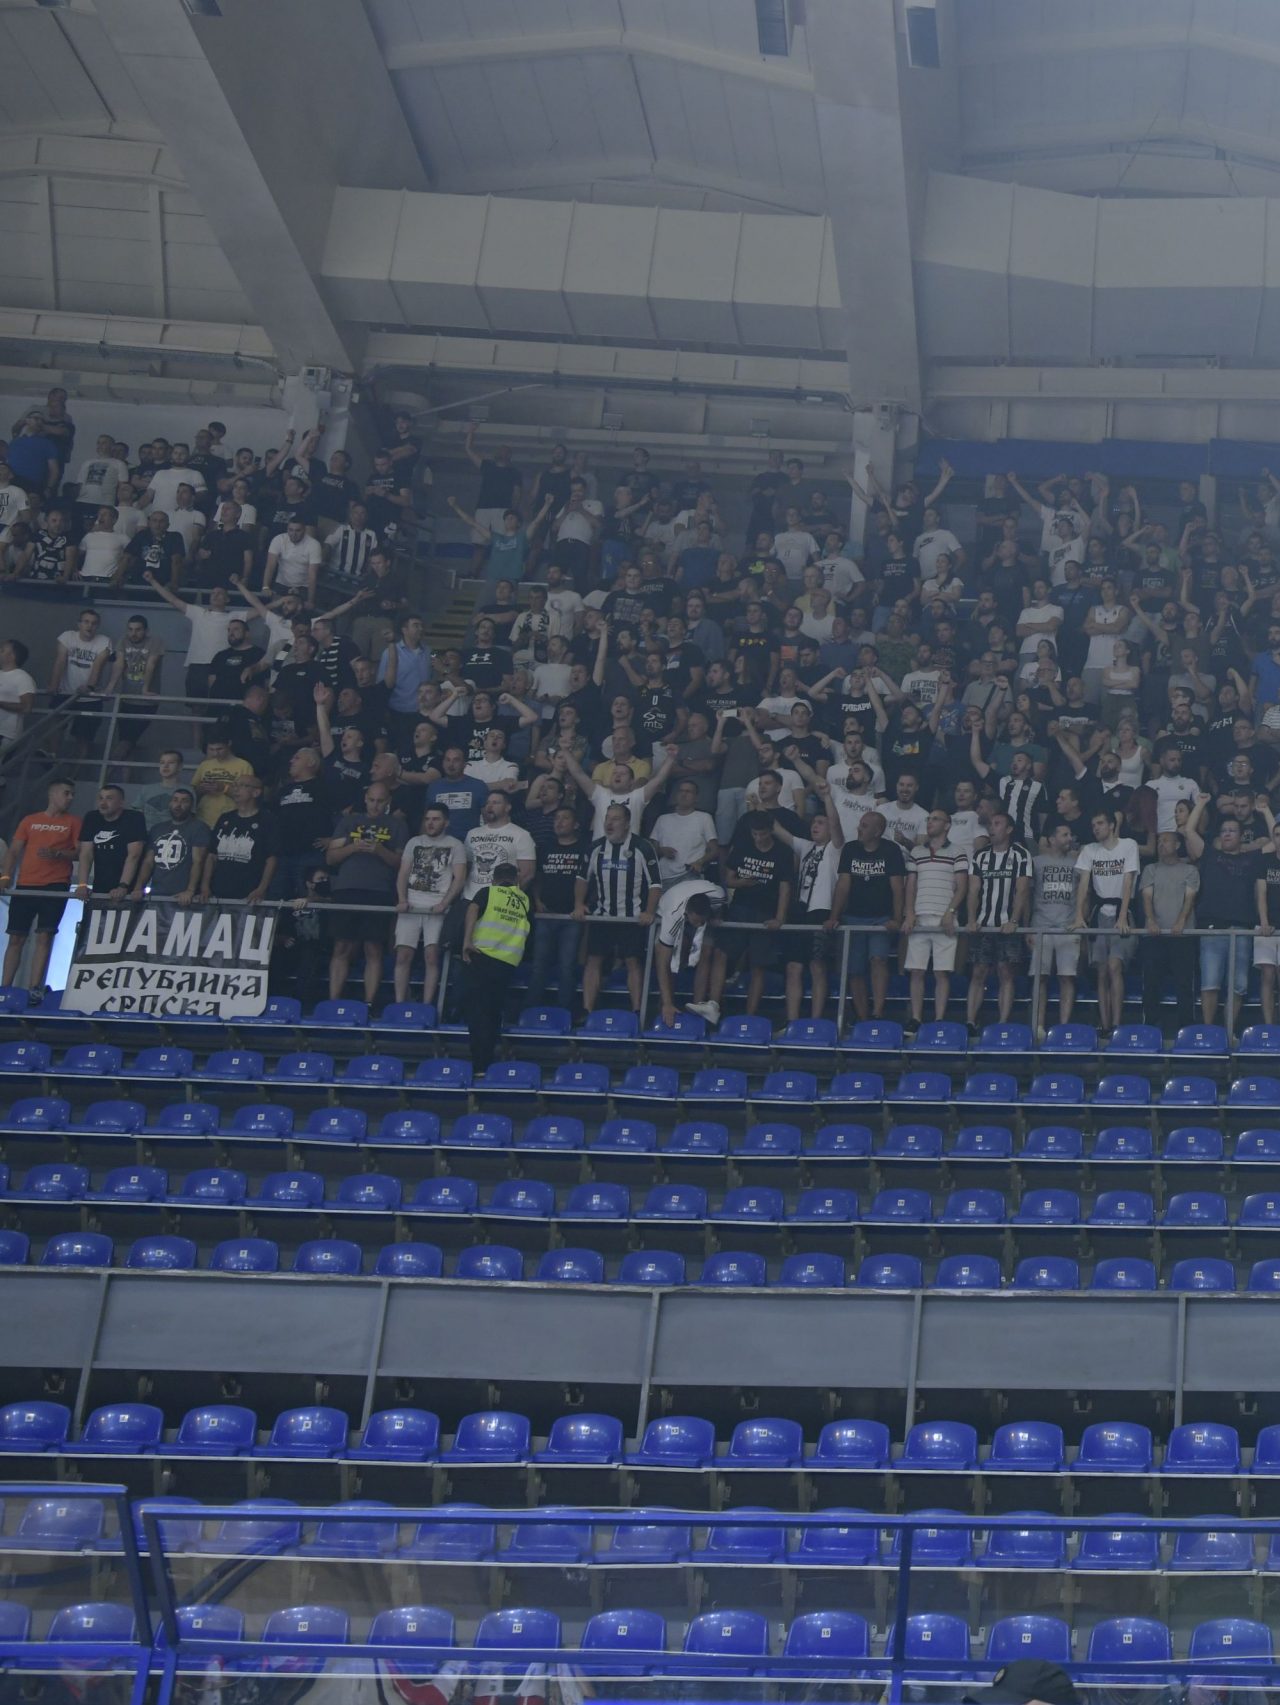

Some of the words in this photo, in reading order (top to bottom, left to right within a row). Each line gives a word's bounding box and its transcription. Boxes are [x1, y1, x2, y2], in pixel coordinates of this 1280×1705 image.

[31, 823, 69, 833] replay
[154, 839, 182, 864] 30
[1042, 874, 1073, 883] KLUB
[504, 896, 521, 910] 743
[1043, 892, 1071, 901] GRAD
[85, 909, 273, 966] ШАМАЦ
[74, 967, 261, 999] РЕПУБЛИКА
[99, 994, 221, 1016] СРПСКА
